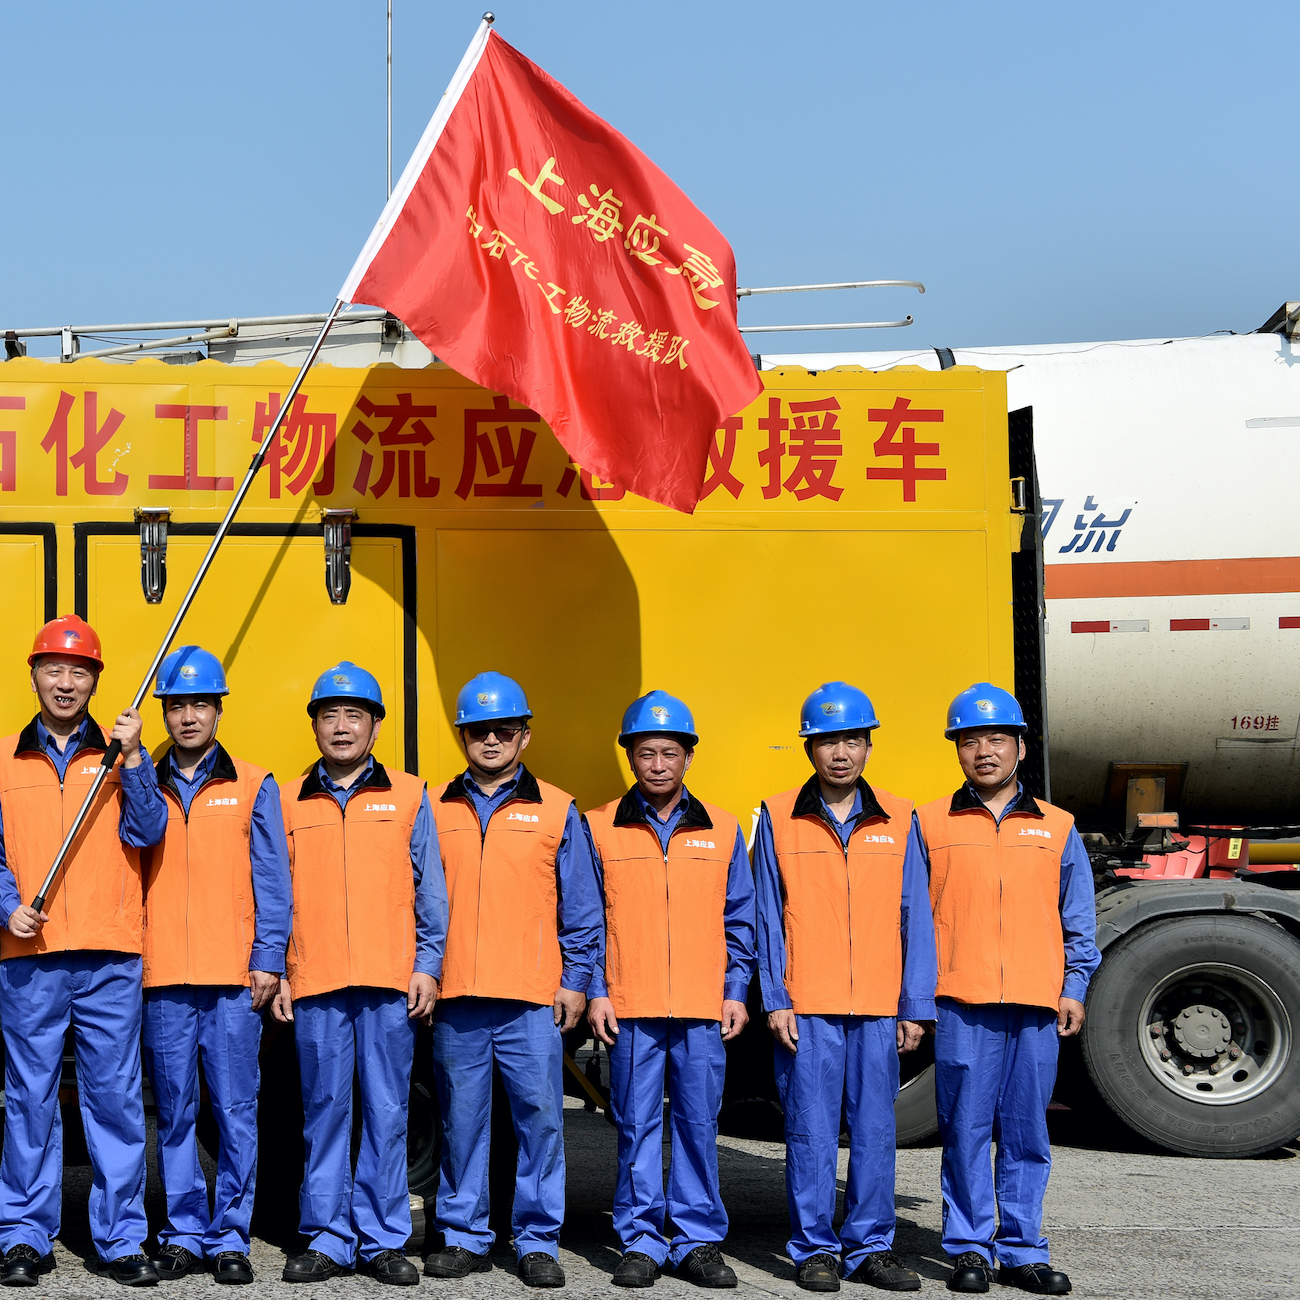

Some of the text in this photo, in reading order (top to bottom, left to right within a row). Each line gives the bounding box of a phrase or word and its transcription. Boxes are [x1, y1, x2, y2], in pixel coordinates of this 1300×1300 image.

[508, 156, 725, 311] 上海应急
[1231, 715, 1280, 731] 169挂
[206, 797, 239, 807] 上海应急
[363, 803, 397, 812] 上海应急
[506, 812, 540, 823] 上海应急
[1018, 828, 1052, 839] 上海应急
[684, 838, 716, 850] 上海应急
